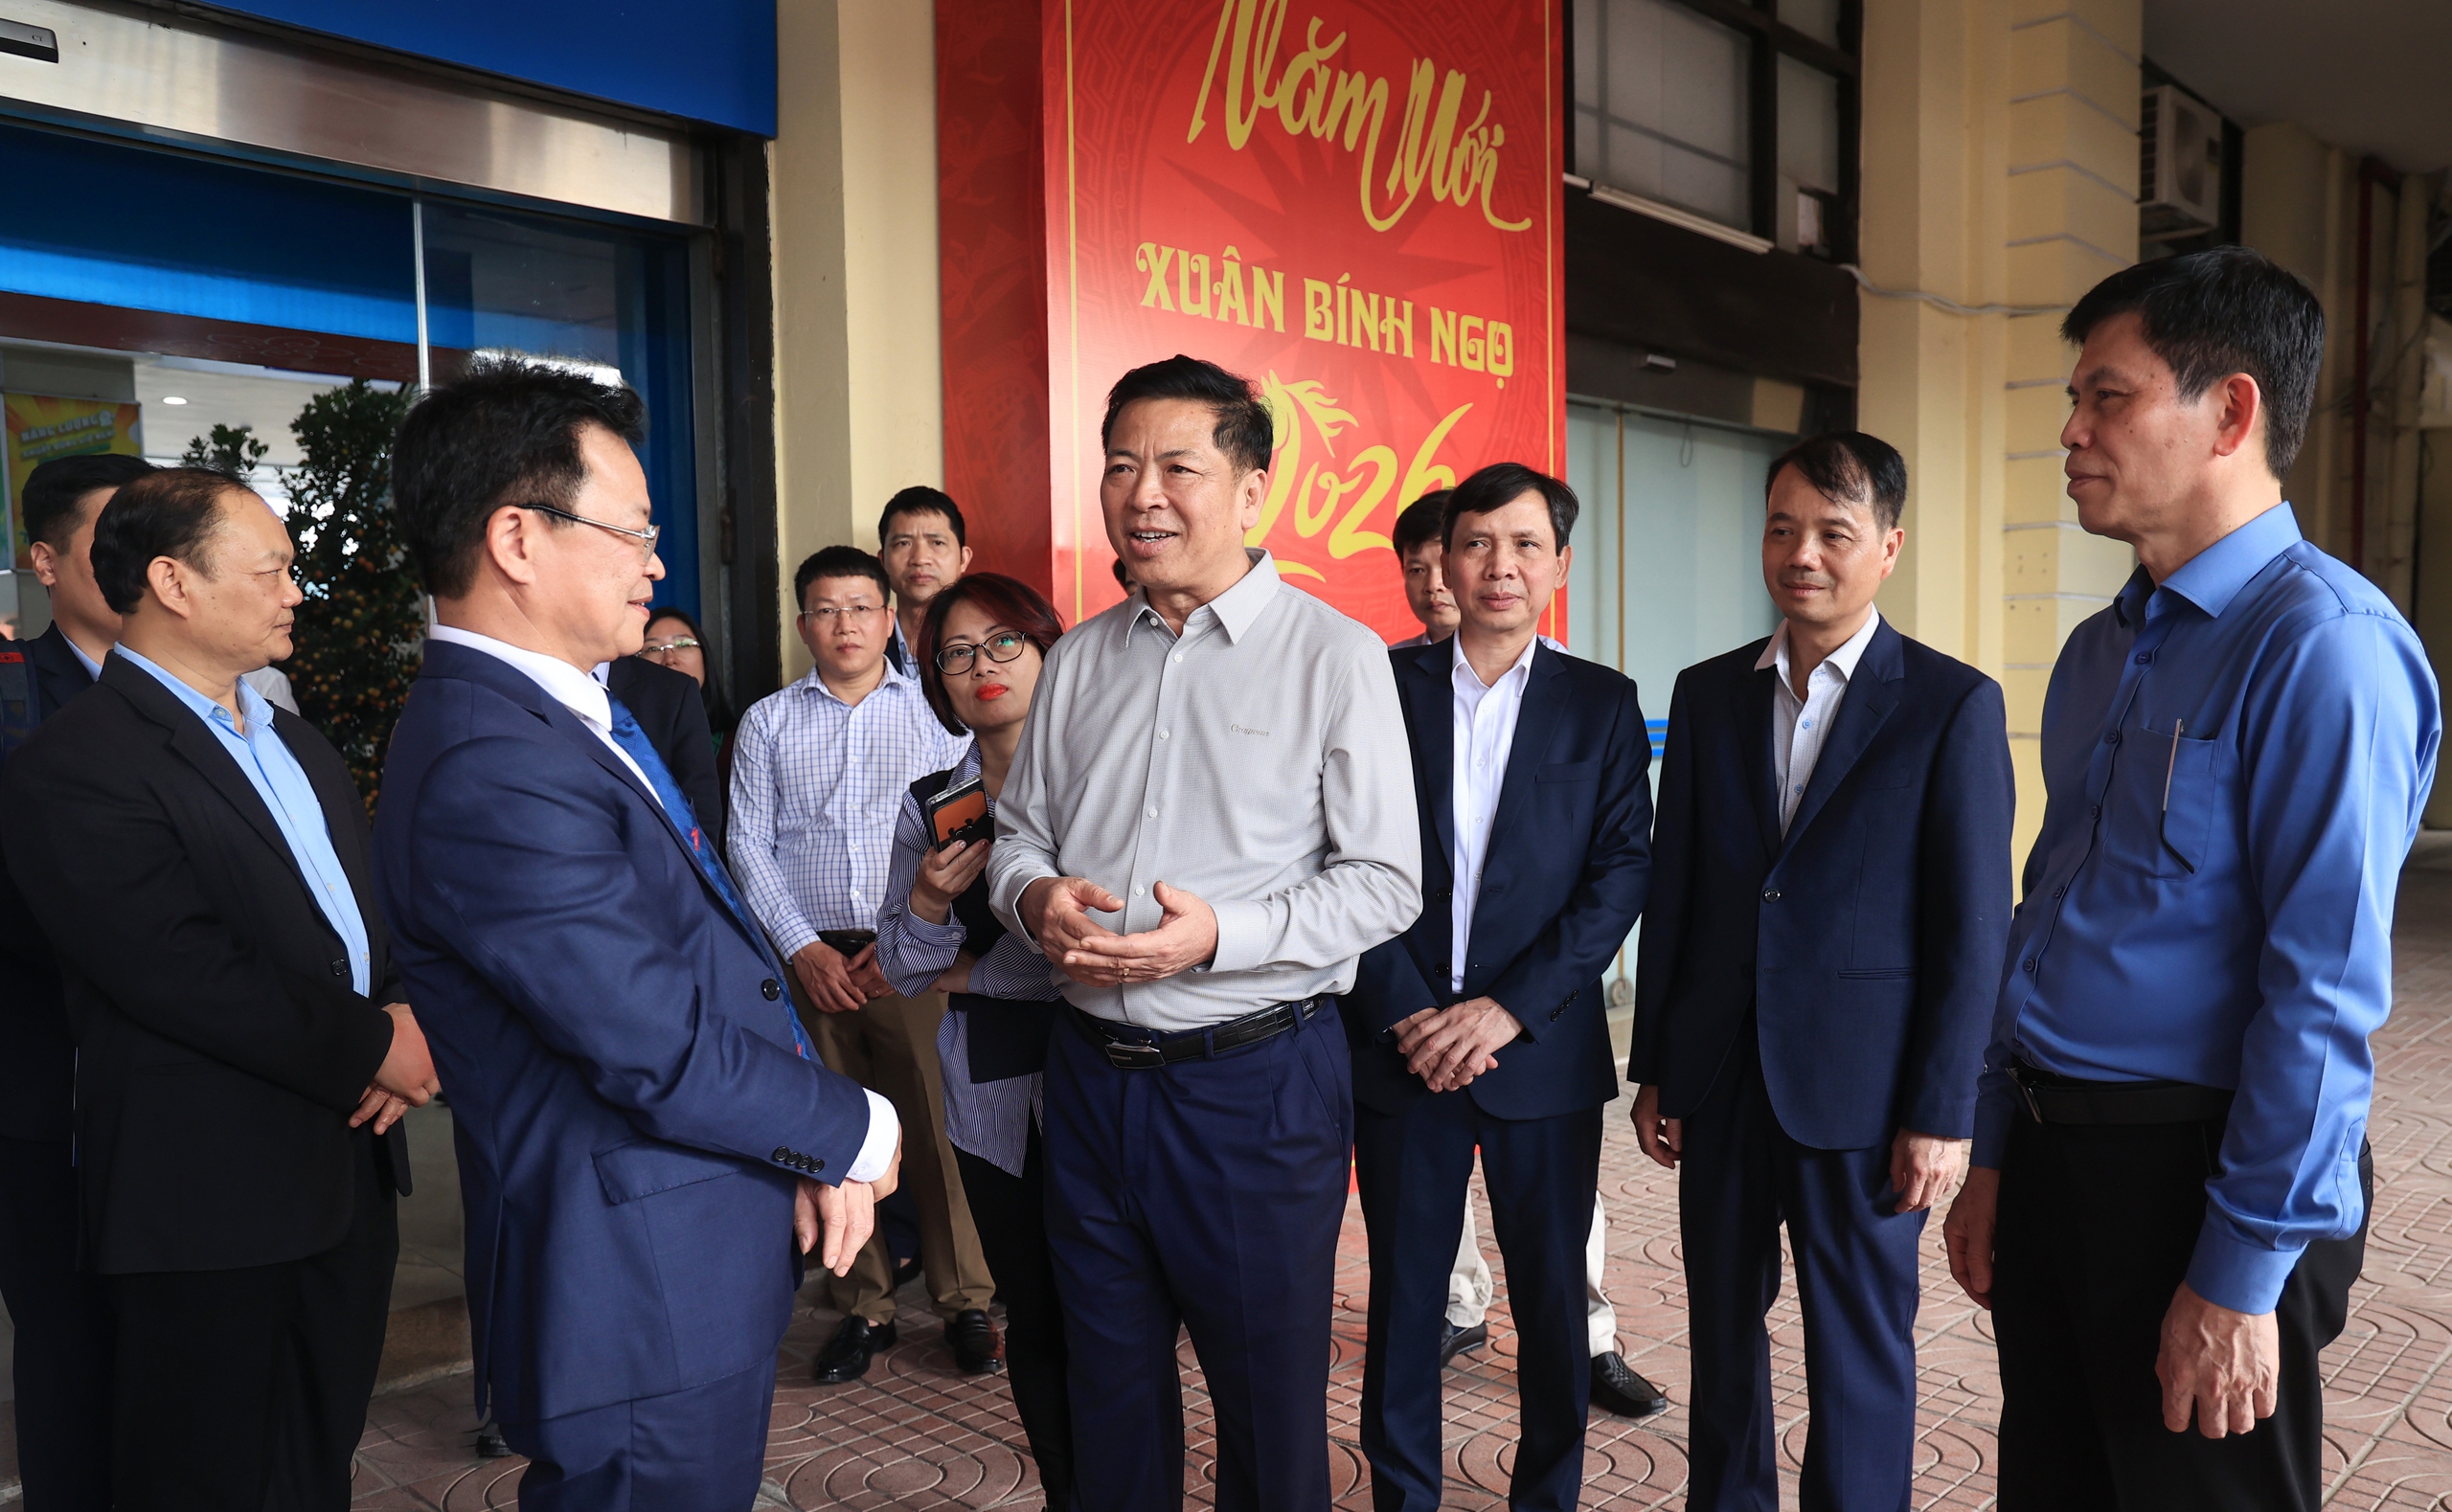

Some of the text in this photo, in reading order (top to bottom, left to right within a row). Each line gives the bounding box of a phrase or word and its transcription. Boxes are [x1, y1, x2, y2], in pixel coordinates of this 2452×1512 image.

[1386, 56, 1532, 232] Mới
[1136, 241, 1514, 390] XUÂN BÍNH NGỌ
